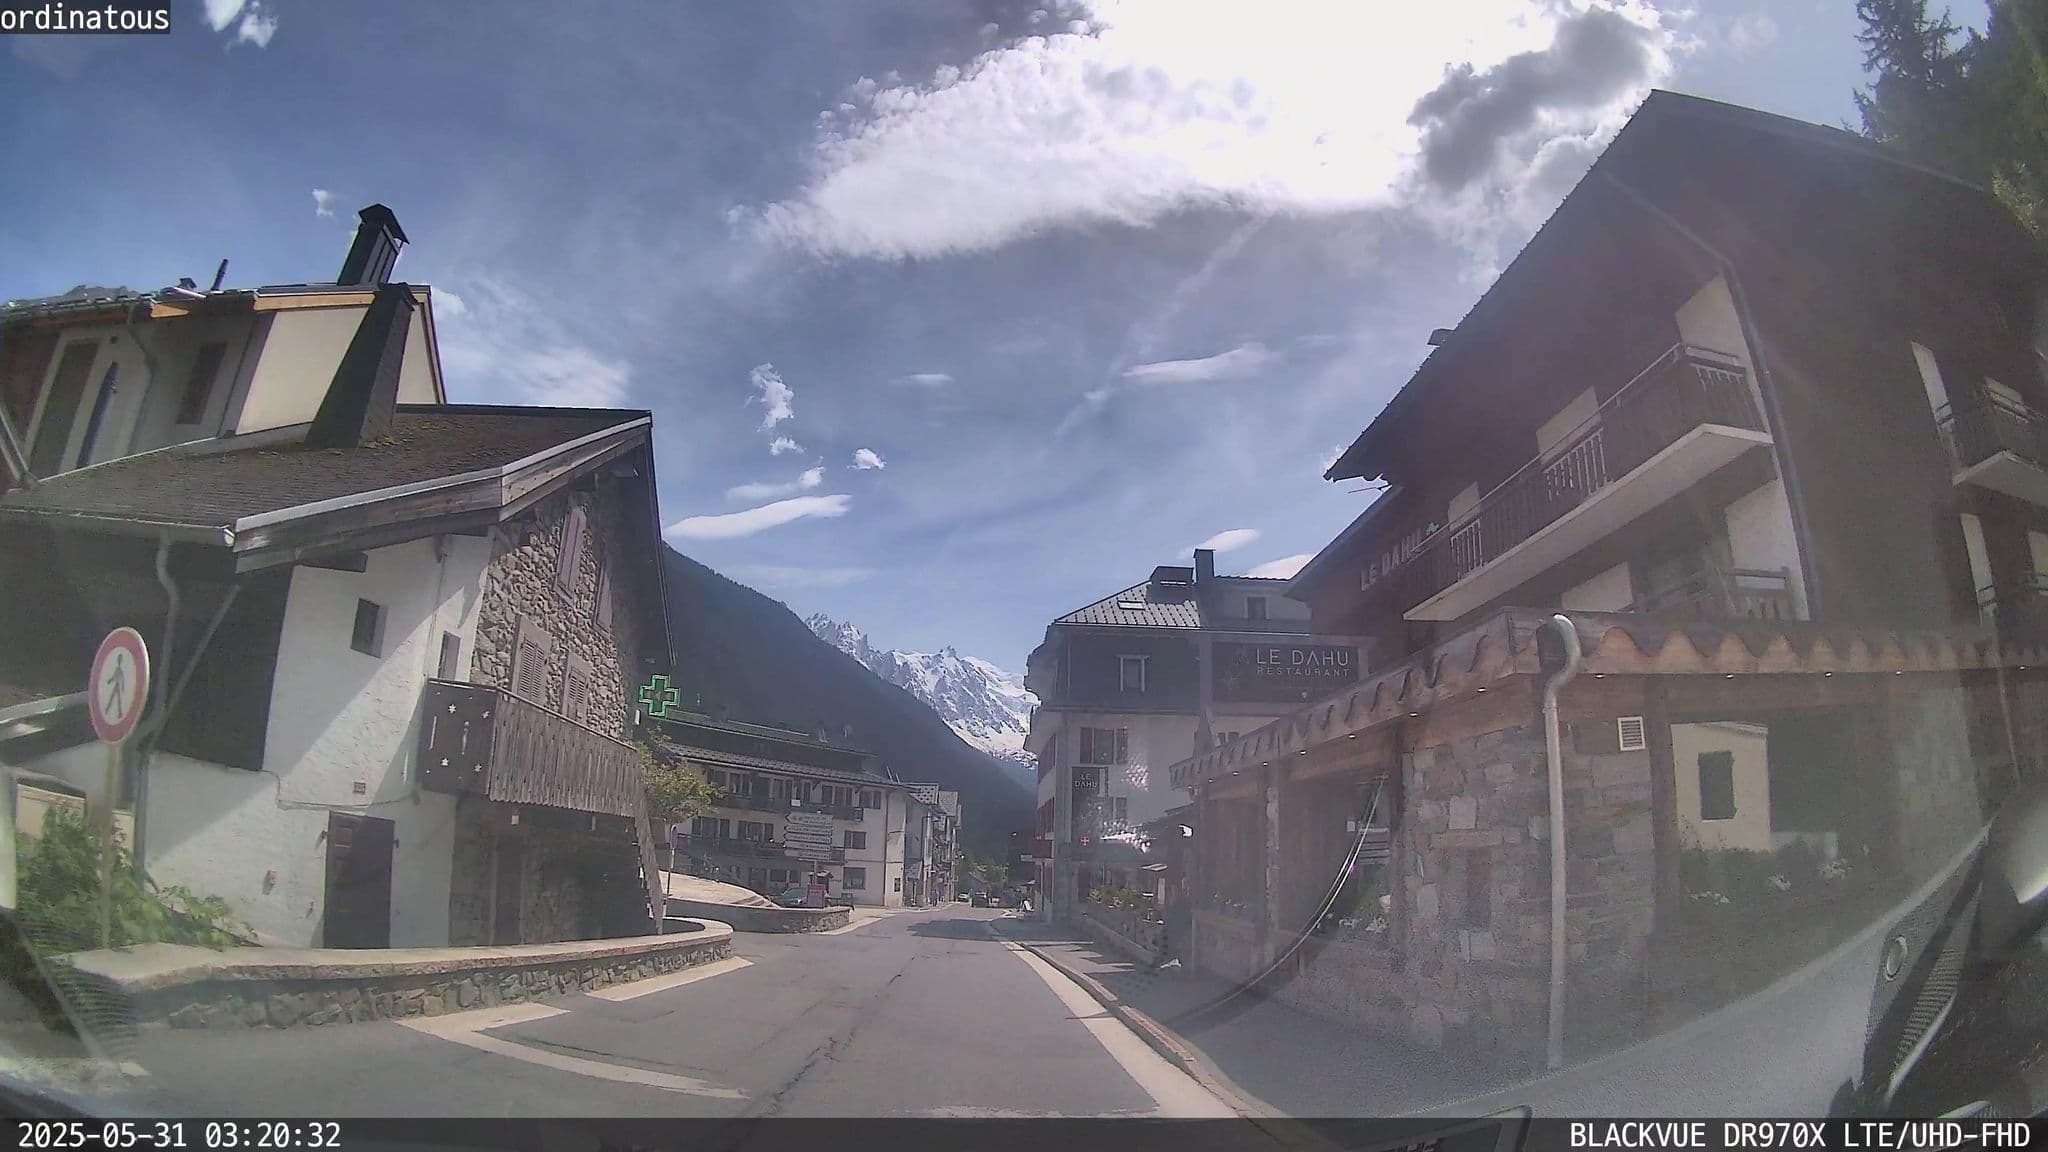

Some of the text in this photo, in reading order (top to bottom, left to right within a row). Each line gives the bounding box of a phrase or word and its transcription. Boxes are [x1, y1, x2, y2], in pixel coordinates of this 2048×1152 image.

[1361, 562, 1377, 592] LE
[1256, 647, 1348, 666] LE DAHU
[1256, 666, 1350, 677] RESTAURANT
[1074, 780, 1097, 788] DAHU
